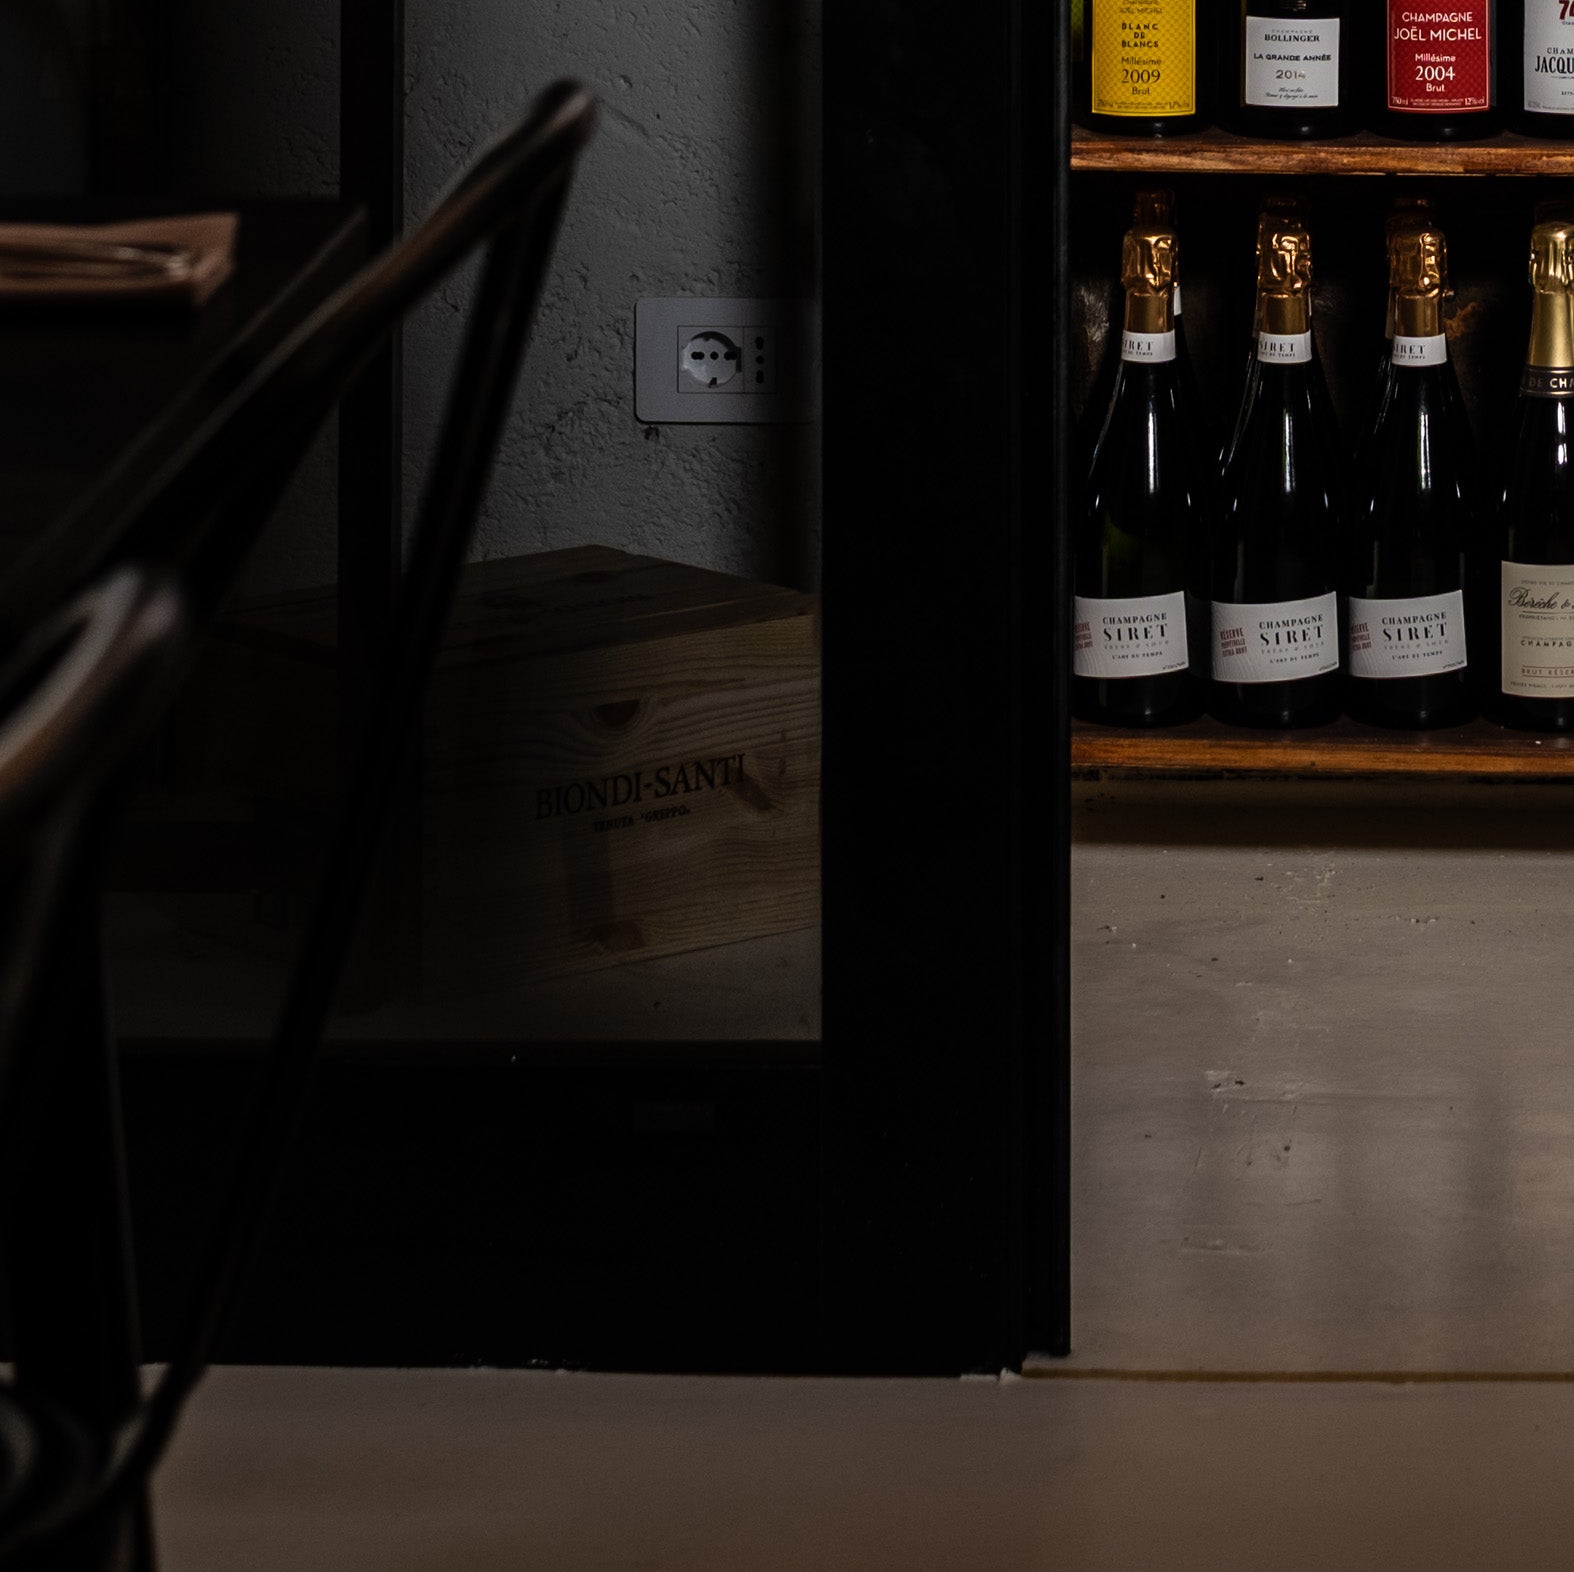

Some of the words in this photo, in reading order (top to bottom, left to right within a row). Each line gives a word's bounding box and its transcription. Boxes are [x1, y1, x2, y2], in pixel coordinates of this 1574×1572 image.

[1402, 11, 1473, 23] CHAMPAGNE
[1264, 34, 1320, 42] BOLLINGER
[1394, 26, 1426, 41] JOËL
[1430, 28, 1481, 41] MICHEL
[1121, 40, 1159, 48] BLANCS
[1121, 57, 1161, 66] Millésime
[1266, 54, 1300, 62] GRANDE
[1303, 53, 1331, 62] ANNÉE
[1415, 52, 1456, 62] Millésime
[1121, 69, 1161, 83] 2009
[1415, 66, 1455, 81] 2004
[1131, 87, 1150, 95] Brut
[1426, 83, 1445, 92] Brut
[1103, 613, 1167, 625] CHAMPAGNE
[1259, 614, 1324, 629] CHAMPAGNE
[1382, 611, 1447, 625] CHAMPAGNE
[1104, 623, 1168, 641] SIRET
[1220, 627, 1244, 640] RÉSERVE
[1260, 625, 1324, 646] SIRET
[1383, 623, 1447, 642] SIRET
[535, 753, 745, 820] BIONDI-SANTI
